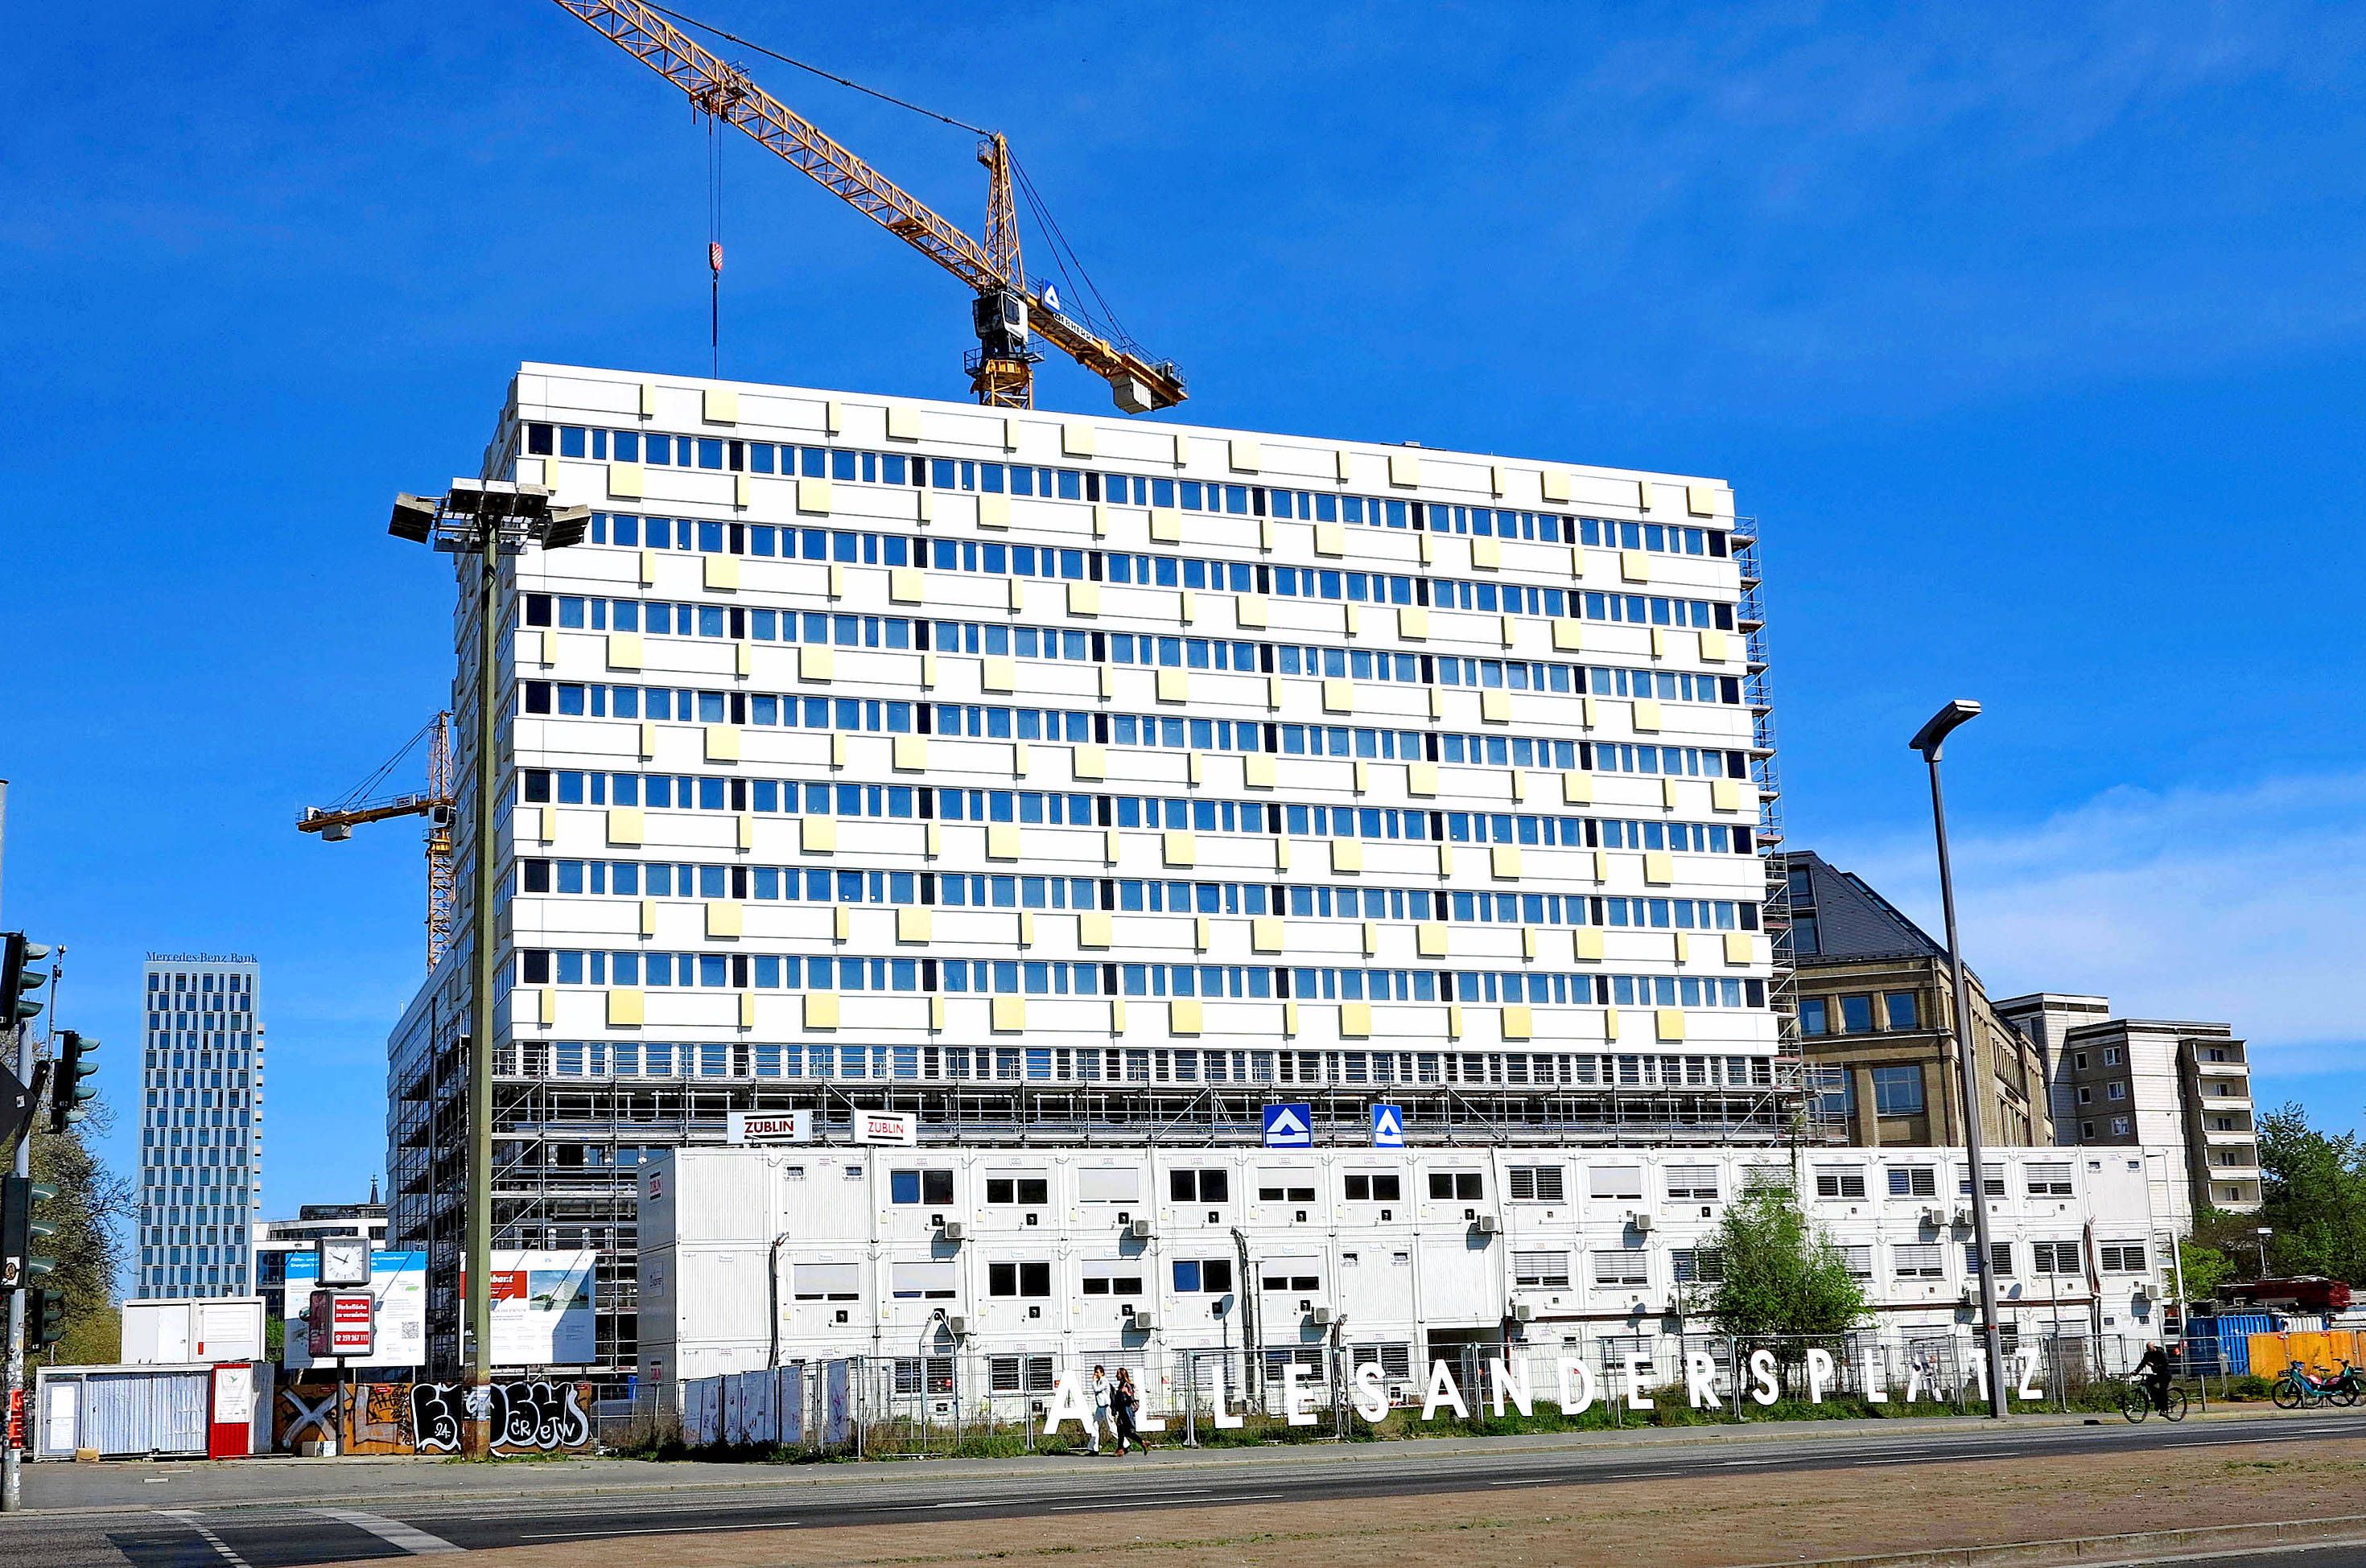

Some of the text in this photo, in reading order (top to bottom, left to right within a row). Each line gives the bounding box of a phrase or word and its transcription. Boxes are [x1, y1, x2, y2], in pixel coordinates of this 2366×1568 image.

[146, 951, 258, 963] Mercedes-Benz Bank
[744, 1120, 794, 1134] ZÜBLIN
